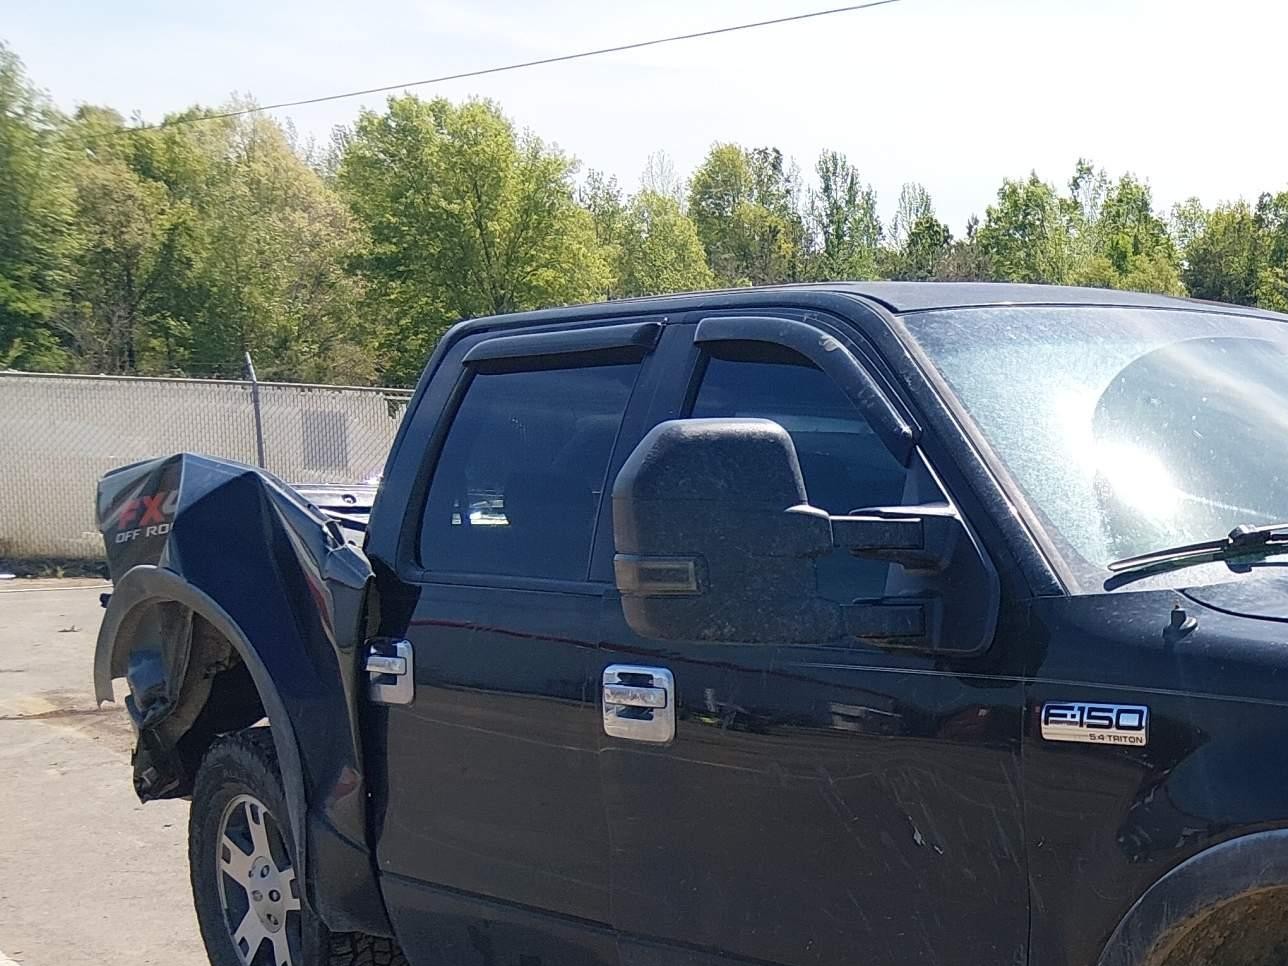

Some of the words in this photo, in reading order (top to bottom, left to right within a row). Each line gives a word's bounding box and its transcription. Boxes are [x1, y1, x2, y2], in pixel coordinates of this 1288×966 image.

[115, 528, 141, 543] OFF
[1043, 705, 1145, 731] F-150
[1106, 734, 1143, 744] TRITON
